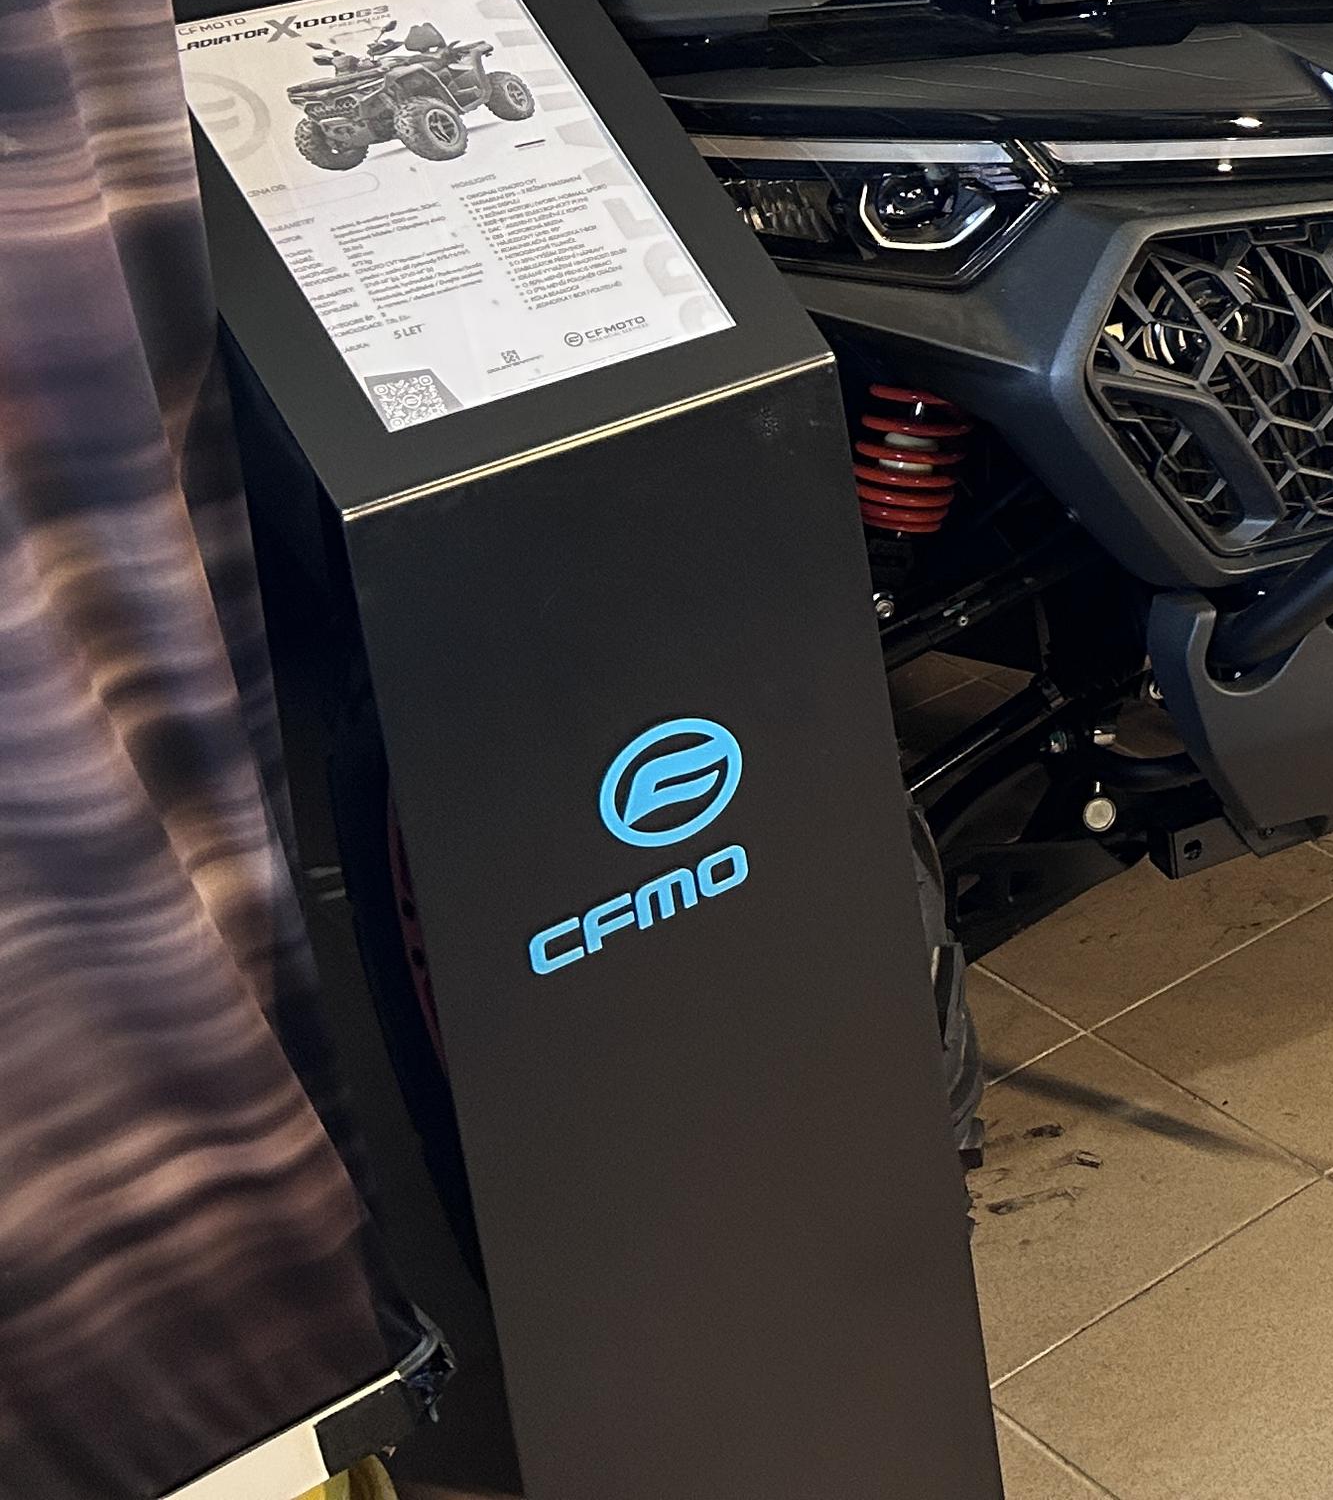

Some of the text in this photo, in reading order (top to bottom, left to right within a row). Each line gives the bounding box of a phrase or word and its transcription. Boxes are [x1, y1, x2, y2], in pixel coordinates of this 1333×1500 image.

[179, 27, 269, 52] ADIATOR
[585, 315, 646, 339] CFMOTO
[528, 844, 749, 975] CFMO
